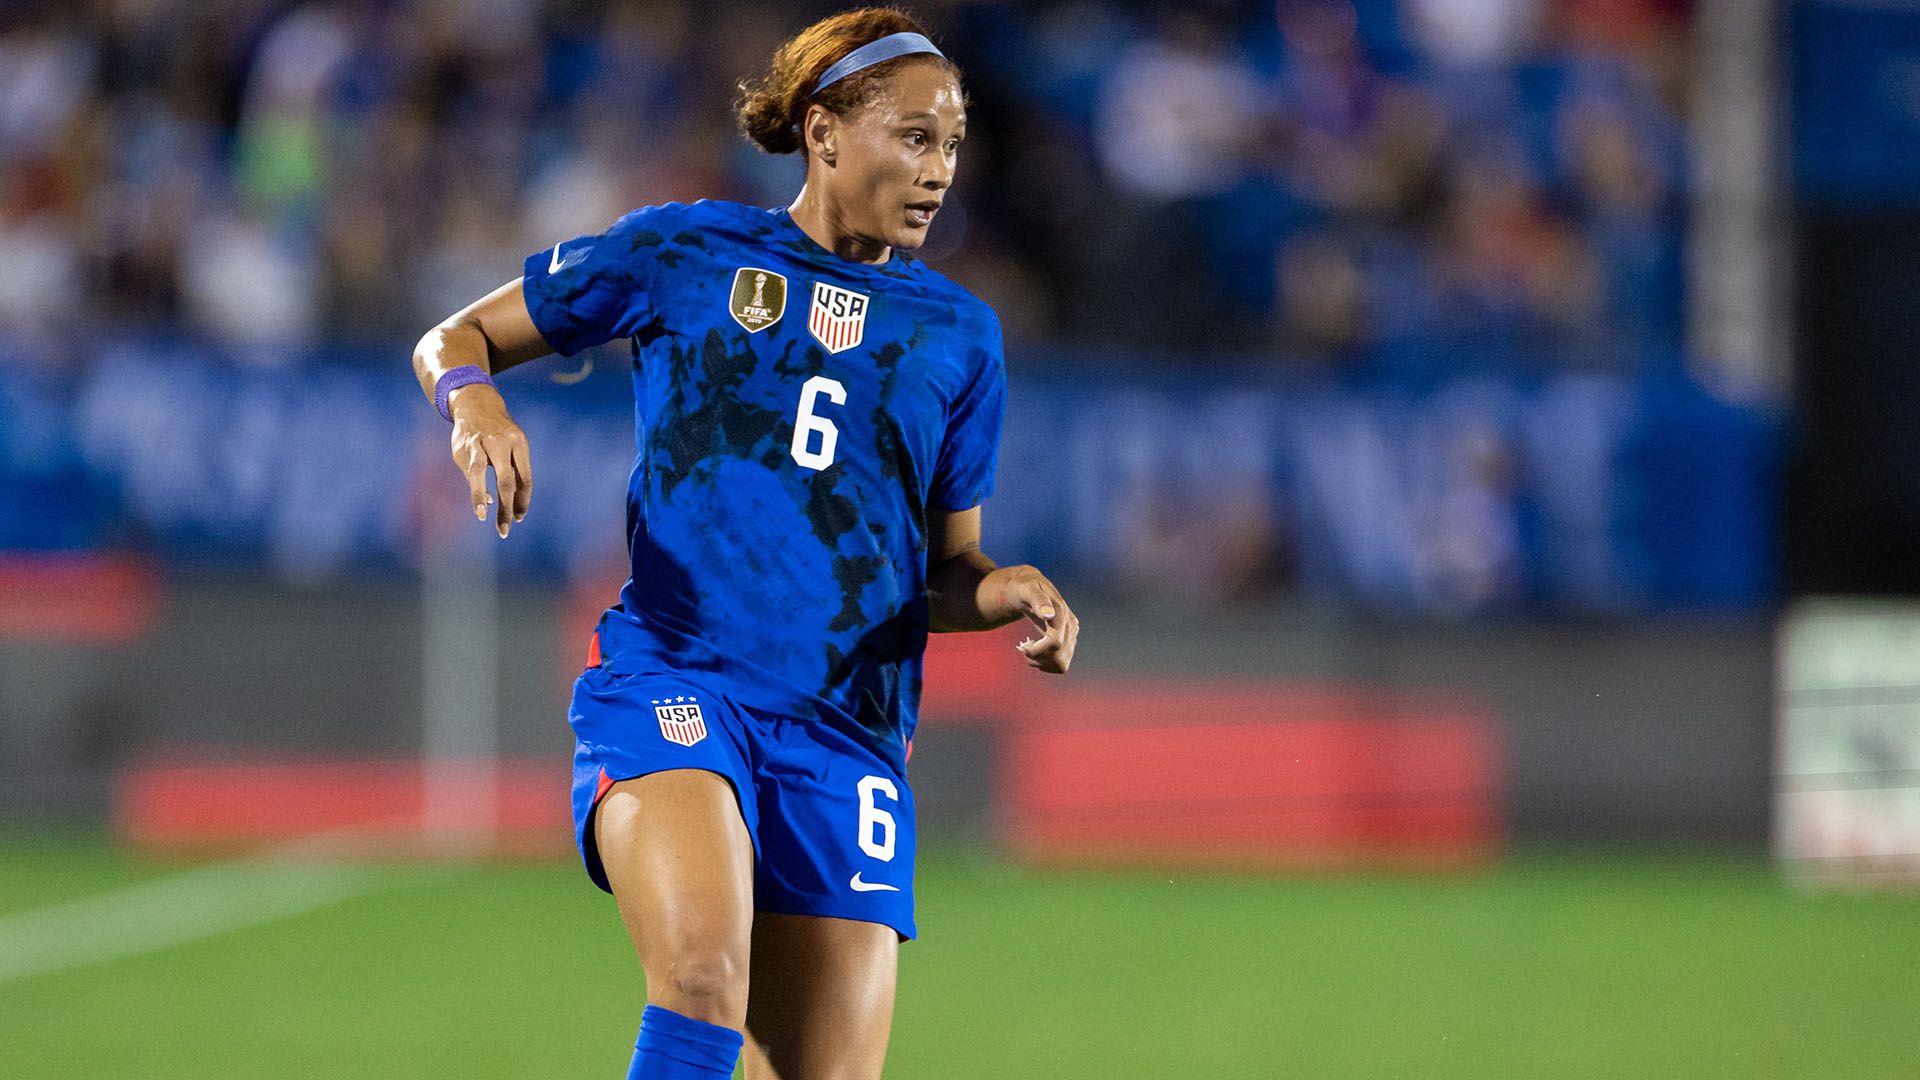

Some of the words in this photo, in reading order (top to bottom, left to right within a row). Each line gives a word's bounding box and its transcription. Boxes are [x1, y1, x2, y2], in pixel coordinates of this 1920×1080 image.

[743, 306, 768, 317] FIFA
[817, 286, 865, 317] USA
[791, 375, 847, 472] 6
[659, 707, 699, 722] USA
[857, 774, 899, 862] 6
